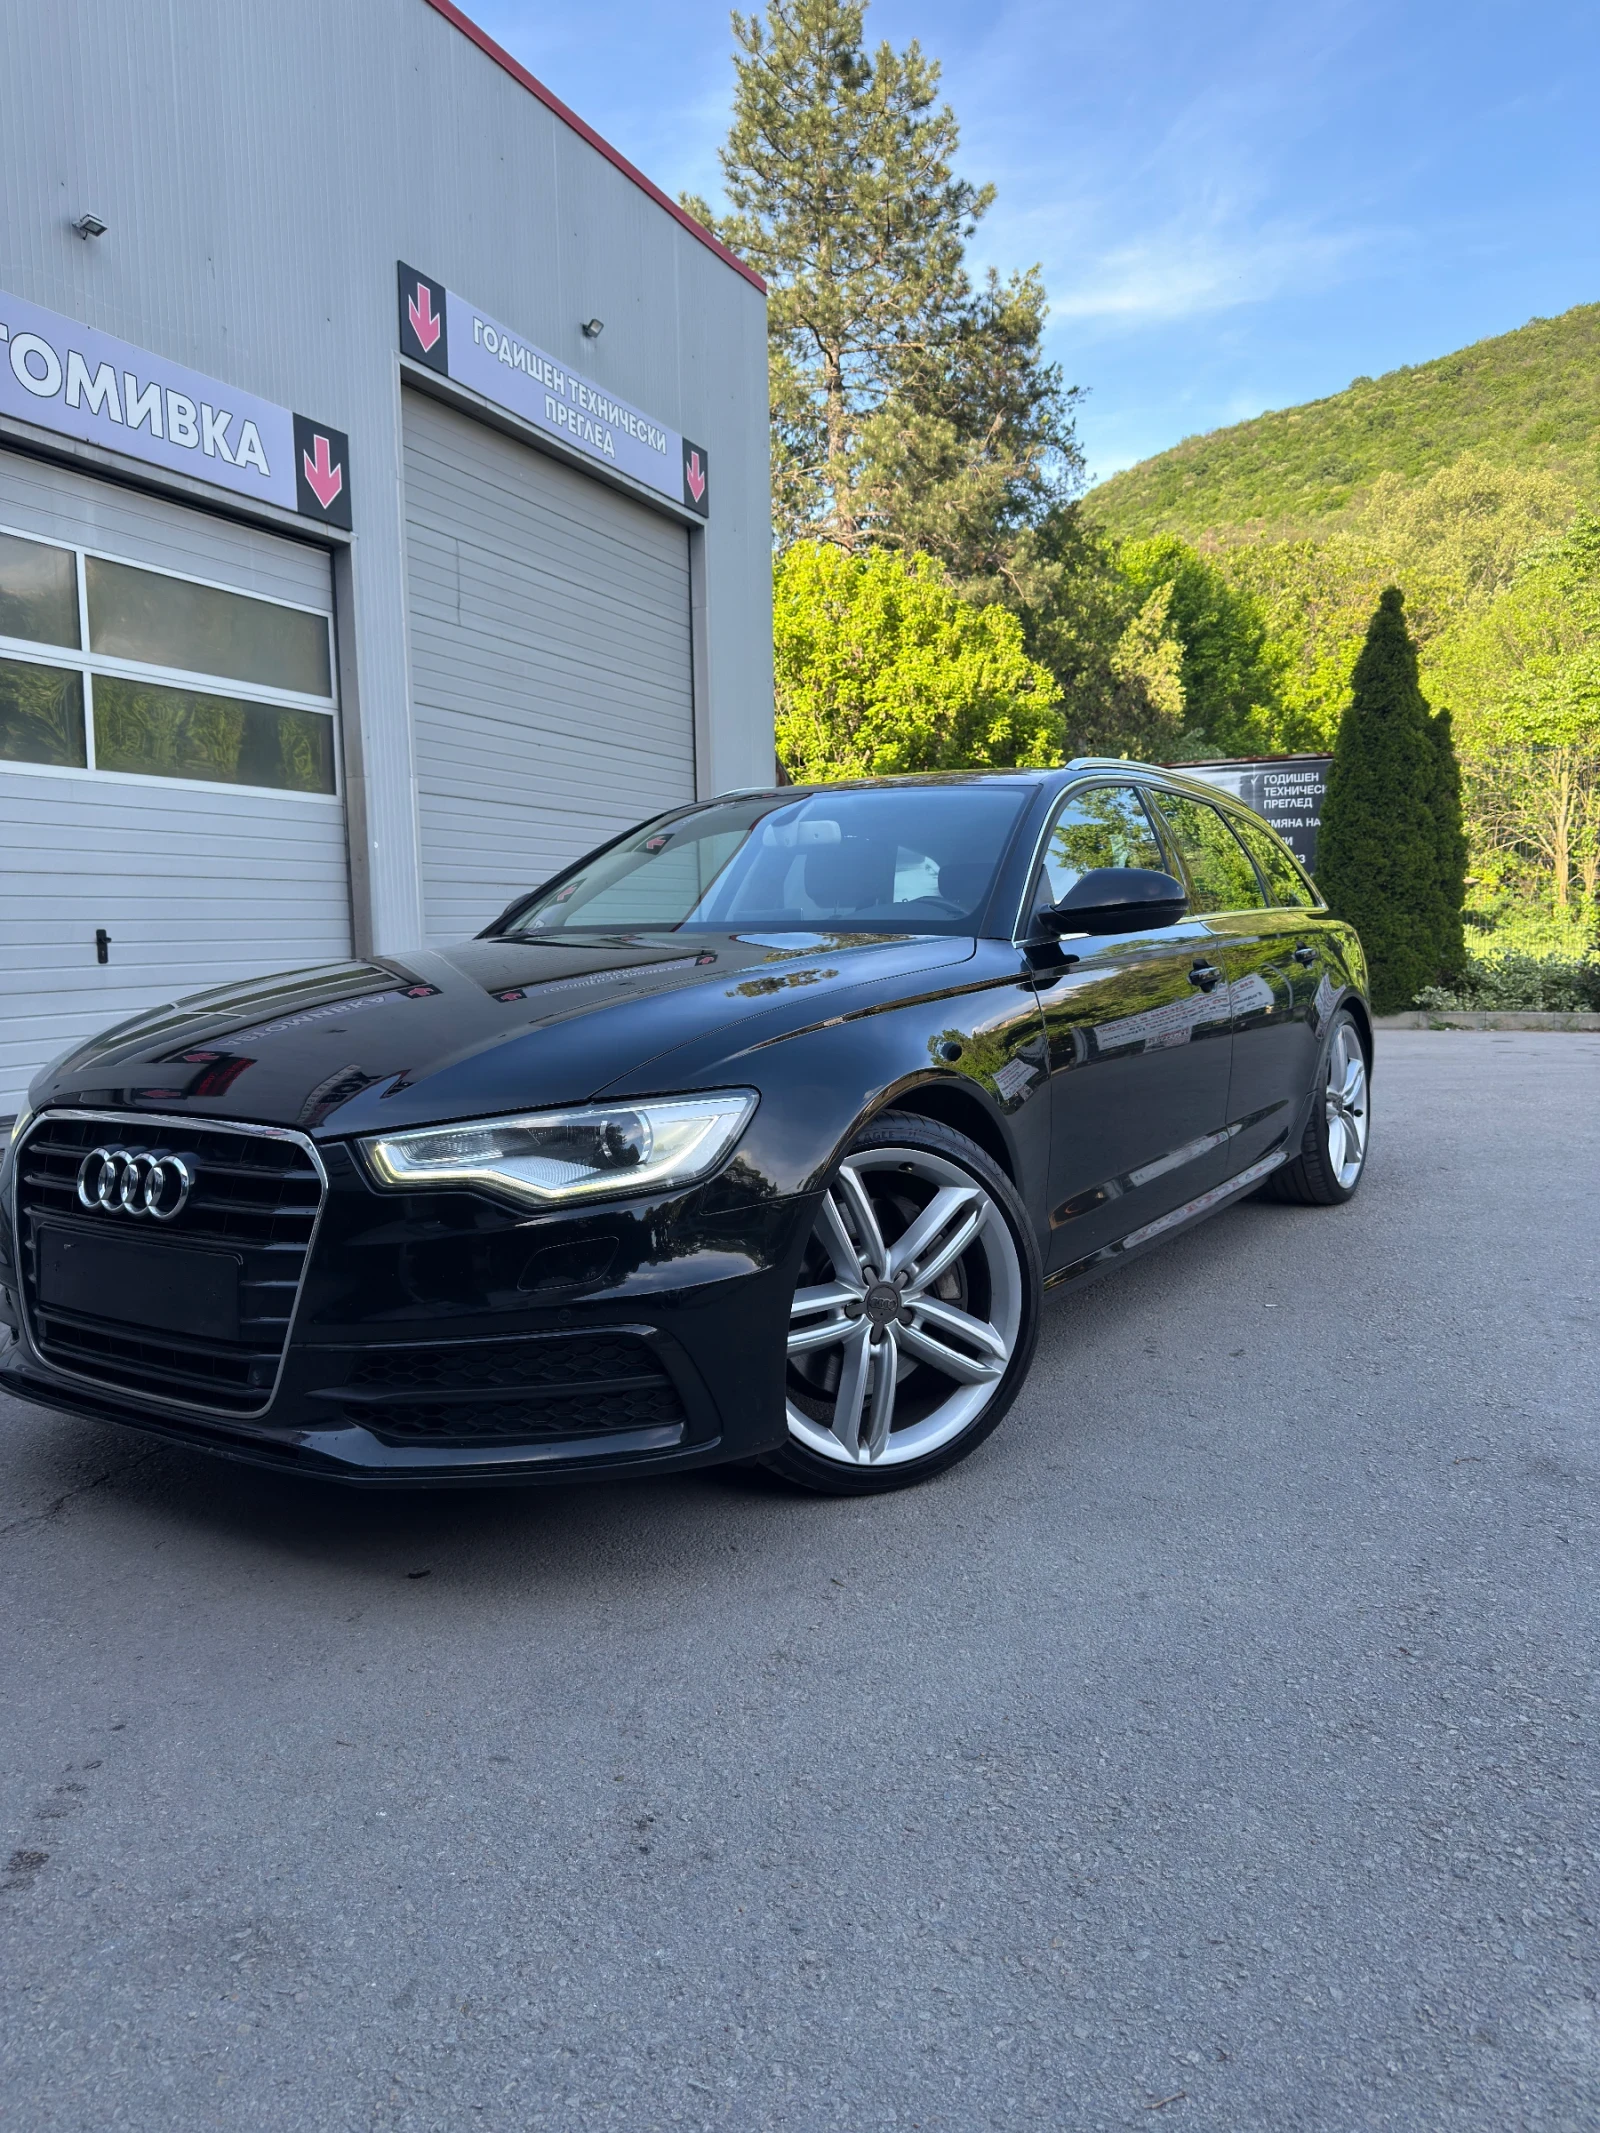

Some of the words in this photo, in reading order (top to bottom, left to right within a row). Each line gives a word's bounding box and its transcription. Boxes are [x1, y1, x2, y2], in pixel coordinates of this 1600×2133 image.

[0, 322, 271, 477] ОМИВКА
[473, 316, 565, 396] ГОДИШЕН
[567, 377, 667, 455] ТЕХНИЧЕСКИ
[544, 394, 615, 459] ПРЕГЛЕД
[1263, 773, 1319, 785] ГОДИШЕН
[1263, 798, 1312, 809] ПРЕГЛЕД
[1266, 817, 1303, 828] МЯНА
[1306, 817, 1321, 827] НА
